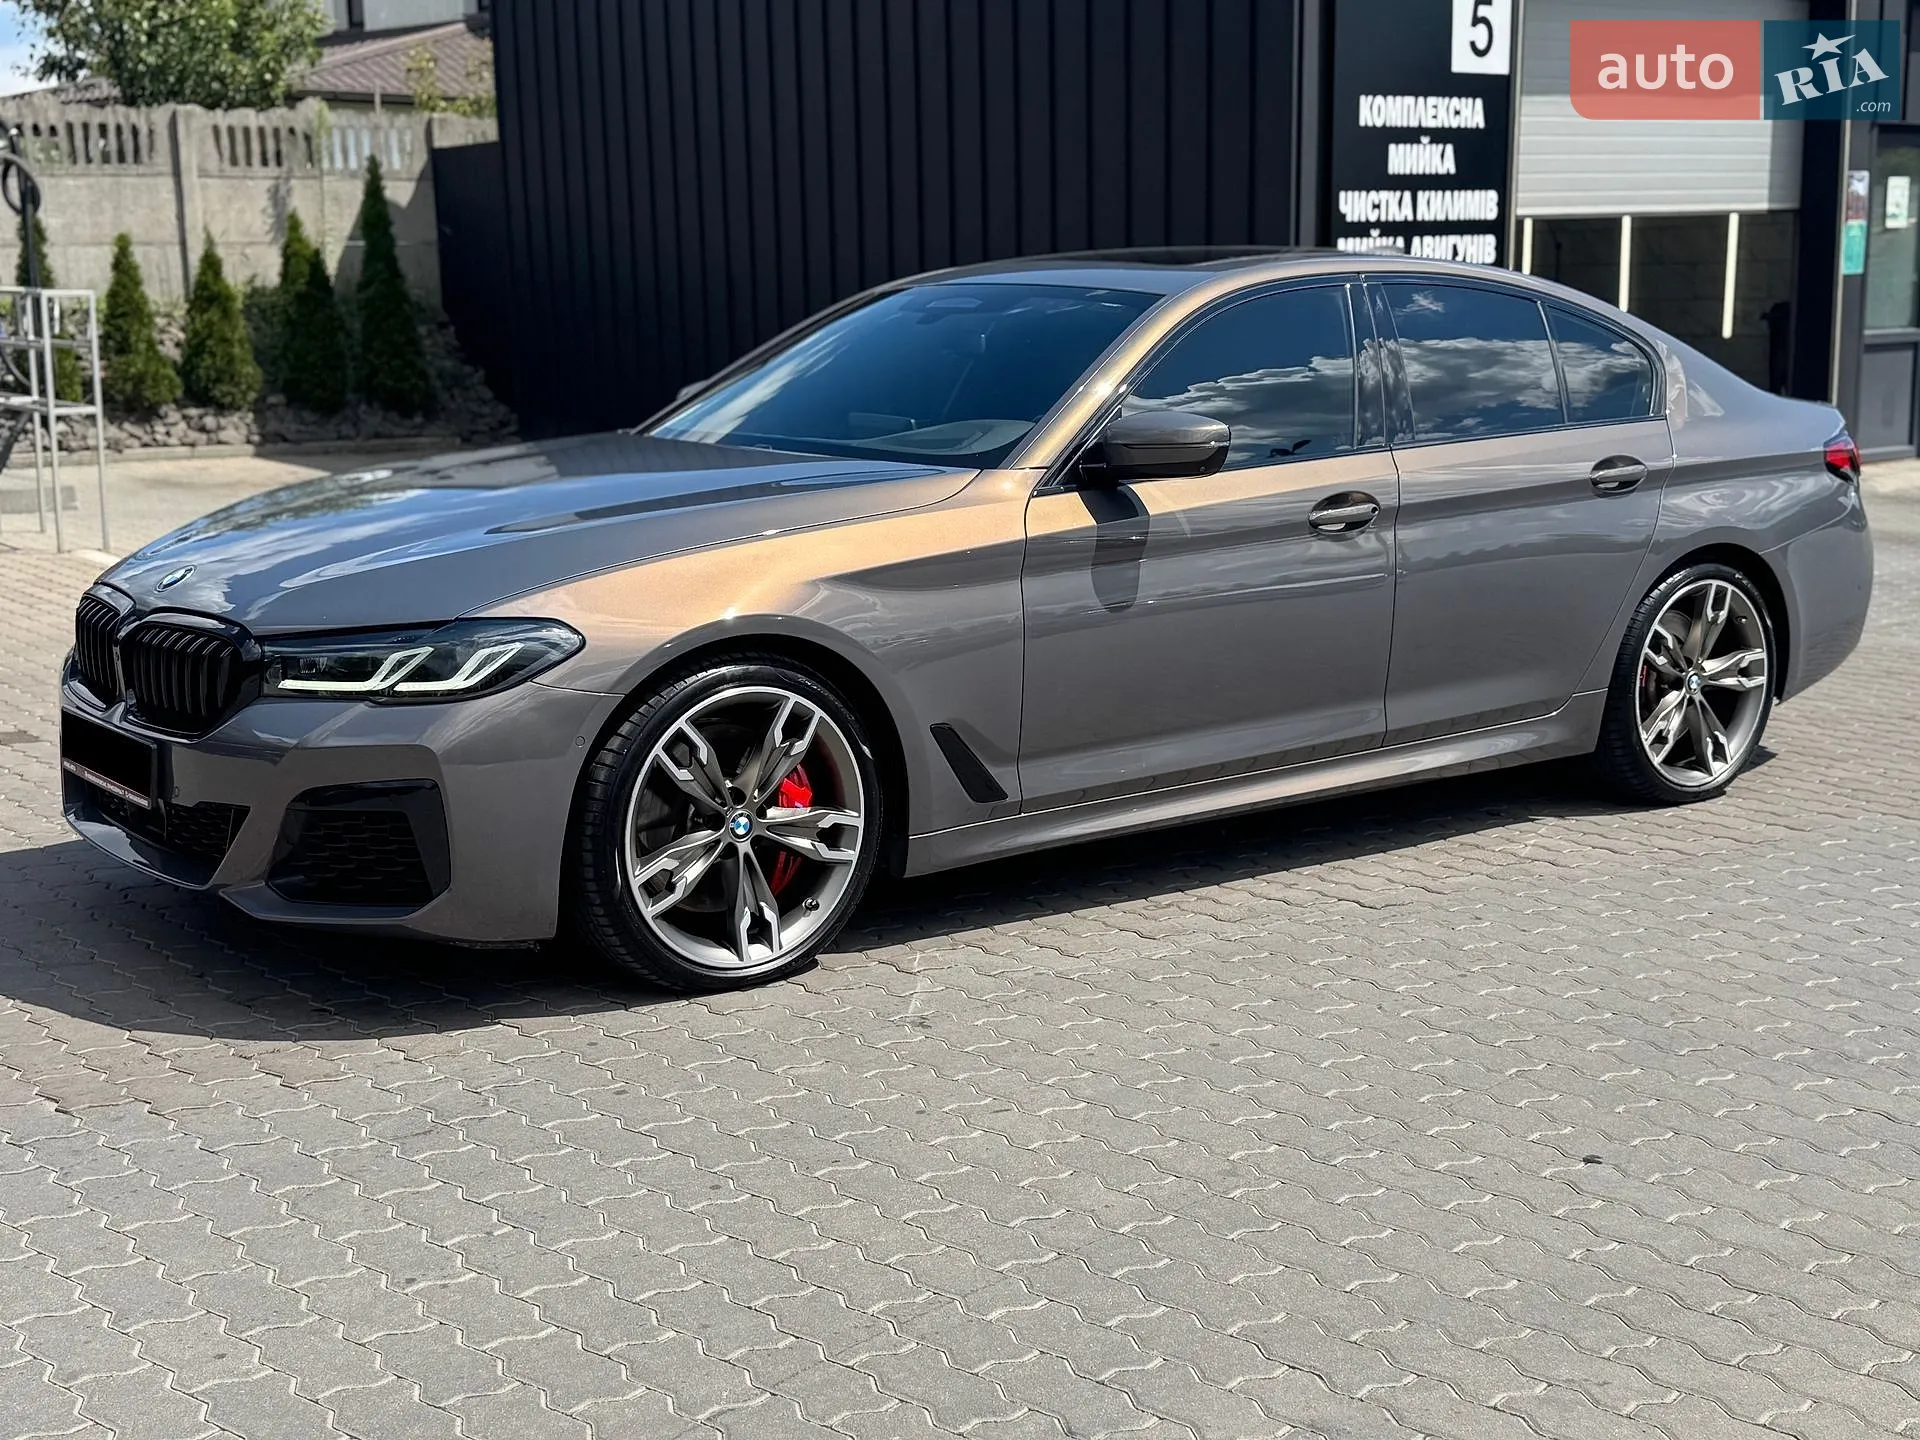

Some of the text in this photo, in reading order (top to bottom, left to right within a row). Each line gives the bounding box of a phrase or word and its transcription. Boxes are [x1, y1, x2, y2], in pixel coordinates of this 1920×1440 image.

[1470, 0, 1493, 58] 5
[1359, 94, 1486, 129] КОМПЛЕКСНА
[1387, 135, 1457, 175] МИЙКА
[1338, 189, 1499, 222] ЧИСТКА КИЛИМІВ
